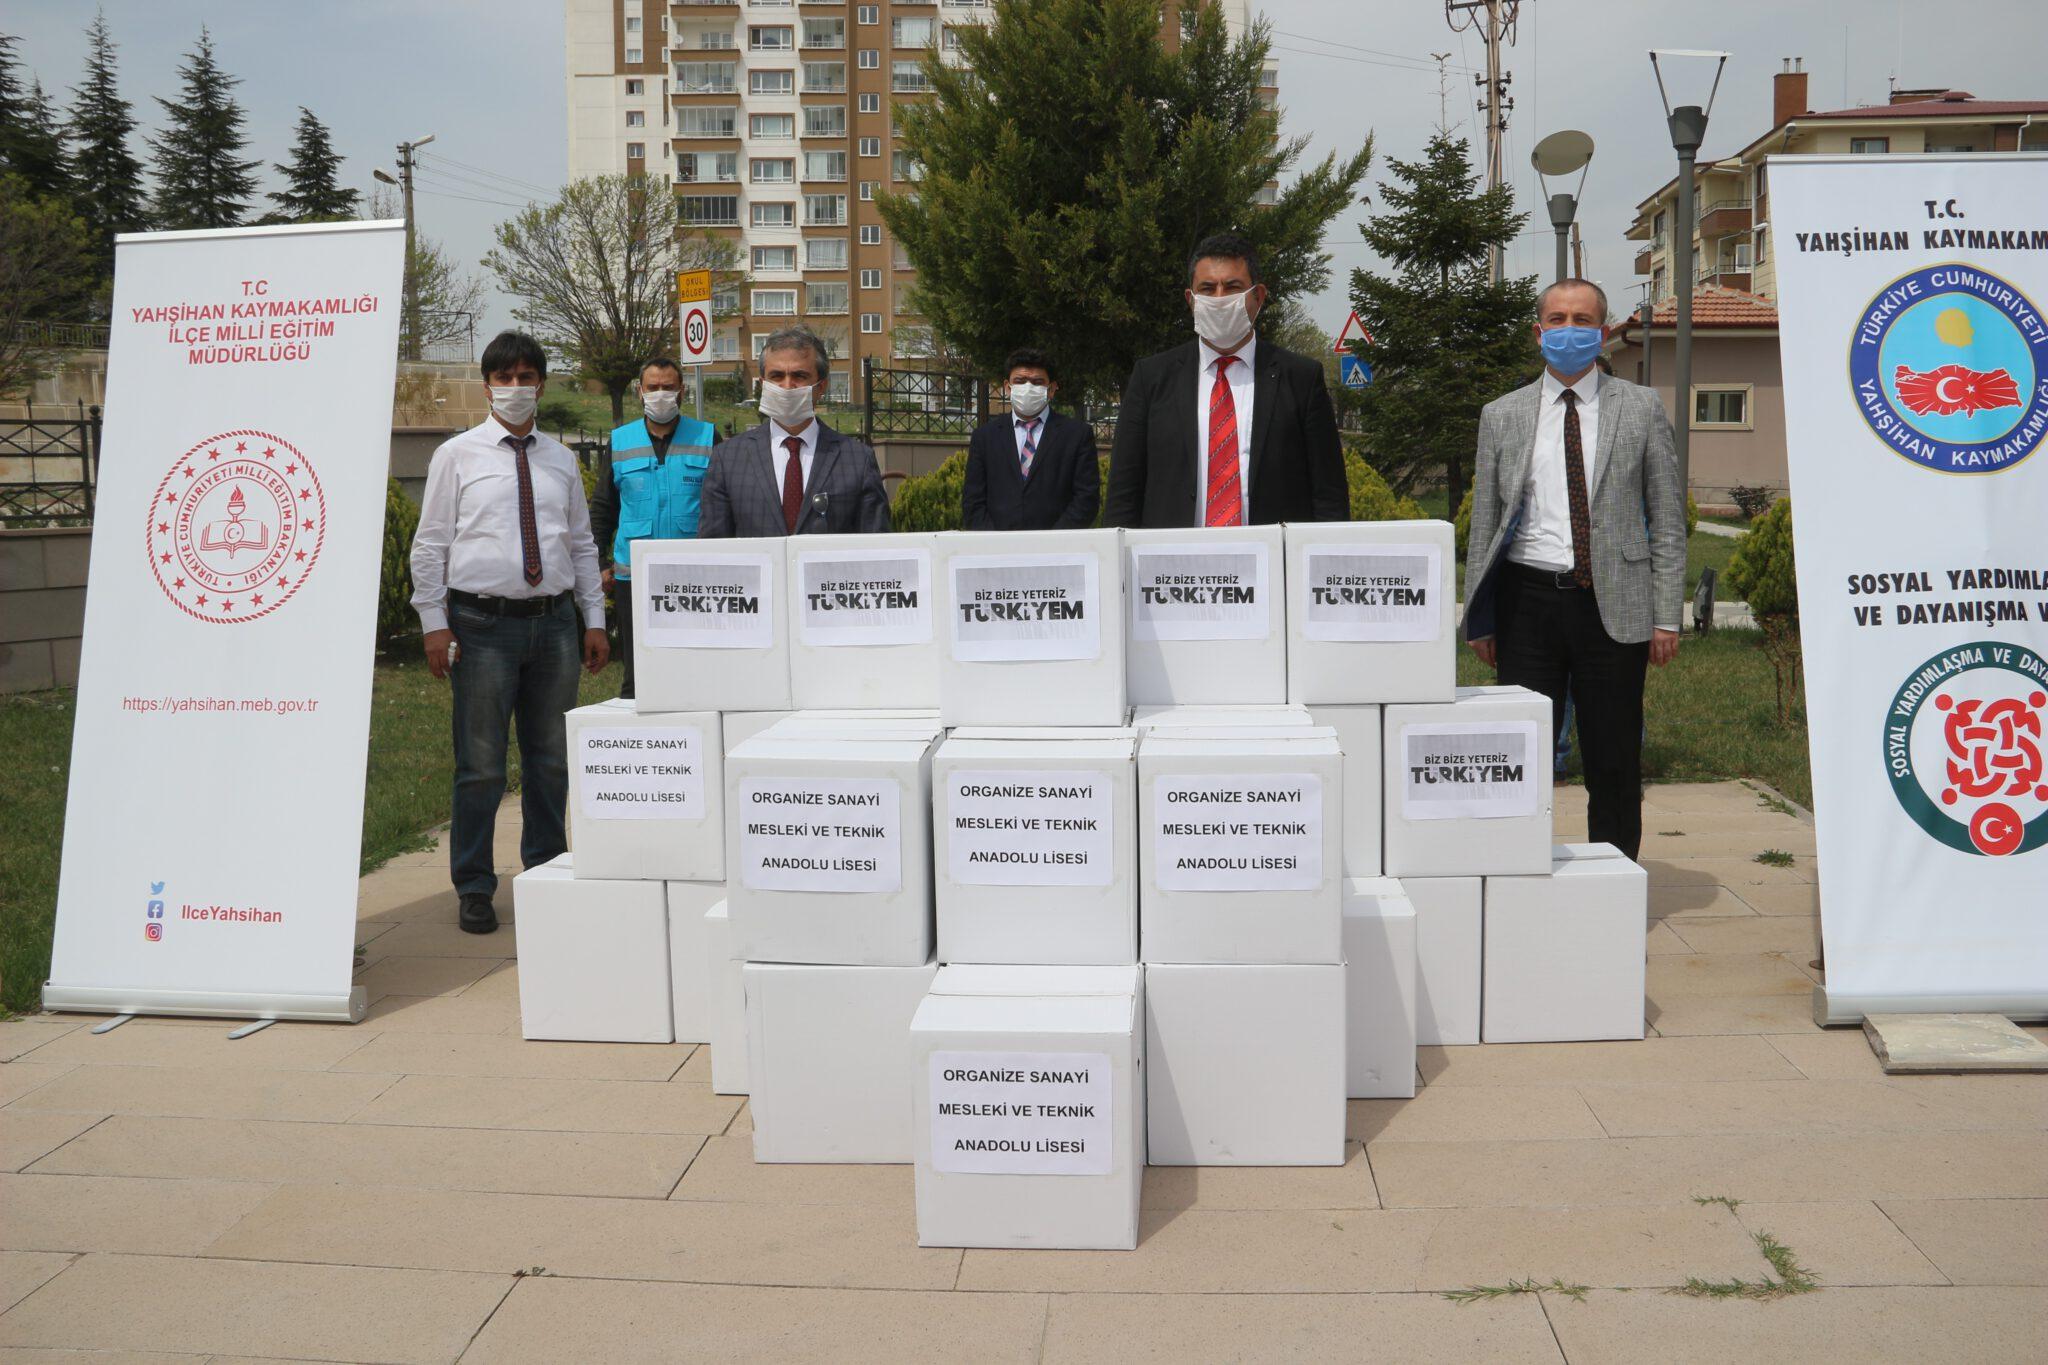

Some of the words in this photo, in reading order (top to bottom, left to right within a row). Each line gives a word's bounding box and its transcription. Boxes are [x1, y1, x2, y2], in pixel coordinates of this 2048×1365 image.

[1925, 199, 1964, 219] T.C.
[1796, 227, 1909, 257] YAHŞİHAN
[242, 280, 268, 296] T.C
[132, 303, 224, 324] YAHŞİHAN
[231, 293, 377, 319] KAYMAKAMLIĞI
[1860, 280, 1922, 347] TÜRKİYE
[1931, 271, 2048, 344] CUMHURİYETİ
[169, 323, 210, 345] İLÇE
[216, 321, 264, 341] MİLLİ
[269, 318, 334, 339] EĞİTİM
[689, 321, 704, 342] 30
[189, 342, 310, 364] MÜDÜRLÜĞÜ
[1860, 378, 1936, 460] YAHŞİHAN
[179, 465, 232, 541] CUMHURİYETİ
[269, 478, 292, 520] EĞİTİM
[244, 524, 292, 584] BAKANLIĞI
[181, 545, 219, 586] TÜRKİYE
[821, 581, 836, 591] BİZ
[839, 580, 861, 590] BİZE
[863, 579, 901, 590] YETERİZ
[1155, 574, 1171, 585] BİZ
[1174, 574, 1196, 585] BİZE
[1199, 574, 1238, 584] YETERİZ
[1326, 575, 1342, 586] BİZ
[1345, 575, 1367, 586] BİZE
[1370, 576, 1410, 586] YETERİZ
[1848, 572, 1932, 594] SOSYAL
[665, 583, 679, 594] BİZ
[682, 584, 703, 594] BİZE
[706, 584, 745, 595] YETERİZ
[975, 589, 992, 600] BİZ
[996, 589, 1020, 600] BİZE
[1024, 587, 1065, 599] YETERİZ
[1141, 587, 1254, 604] TÜRKİYEM
[1312, 588, 1425, 605] TÜRKİYEM
[651, 596, 758, 613] TÜRKİYEM
[808, 592, 917, 610] TÜRKİYEM
[960, 601, 1083, 622] TÜRKİYEM
[1854, 606, 1881, 626] VE
[1897, 601, 2028, 627] DAYANIŞMA
[1993, 647, 2012, 664] VE
[1894, 647, 1984, 717] YARDIMLAŞMA
[123, 697, 318, 715] https://yahsihan.meb.gov.tr
[589, 740, 643, 748] ORGANİZE
[647, 738, 686, 749] SANAYİ
[1889, 725, 1911, 778] SOSYAL
[1425, 754, 1440, 764] BİZ
[1444, 754, 1465, 764] BİZE
[1468, 753, 1507, 763] YETERİZ
[586, 765, 631, 774] MESLEKİ
[635, 766, 648, 774] VE
[652, 766, 691, 774] TEKNİK
[1411, 766, 1522, 783] TÜRKİYEM
[597, 793, 647, 801] ANADOLU
[652, 793, 685, 802] LİSESİ
[752, 793, 823, 804] ORGANİZE
[828, 792, 879, 805] SANAYİ
[961, 784, 1034, 797] ORGANİZE
[1039, 784, 1091, 798] SANAYİ
[1168, 789, 1242, 802] ORGANİZE
[1247, 789, 1300, 802] SANAYİ
[749, 823, 807, 835] MESLEKİ
[812, 824, 829, 836] VE
[834, 826, 884, 837] TEKNİK
[956, 816, 1017, 829] MESLEKİ
[1022, 819, 1039, 829] VE
[1045, 818, 1096, 830] TEKNİK
[1164, 821, 1225, 835] MESLEKİ
[1230, 822, 1248, 834] VE
[1253, 822, 1305, 834] TEKNİK
[762, 858, 828, 869] ANADOLU
[834, 857, 876, 871] LİSESİ
[970, 852, 1038, 863] ANADOLU
[1044, 851, 1087, 864] LİSESİ
[1177, 858, 1246, 869] ANADOLU
[1253, 854, 1296, 869] LİSESİ
[944, 1068, 1024, 1082] ORGANİZE
[1030, 1068, 1088, 1083] SANAYİ
[940, 1102, 1006, 1116] MESLEKİ
[1012, 1105, 1031, 1116] VE
[1037, 1103, 1094, 1117] TEKNİK
[955, 1138, 1030, 1152] ANADOLU
[1037, 1138, 1084, 1152] LİSESİ
